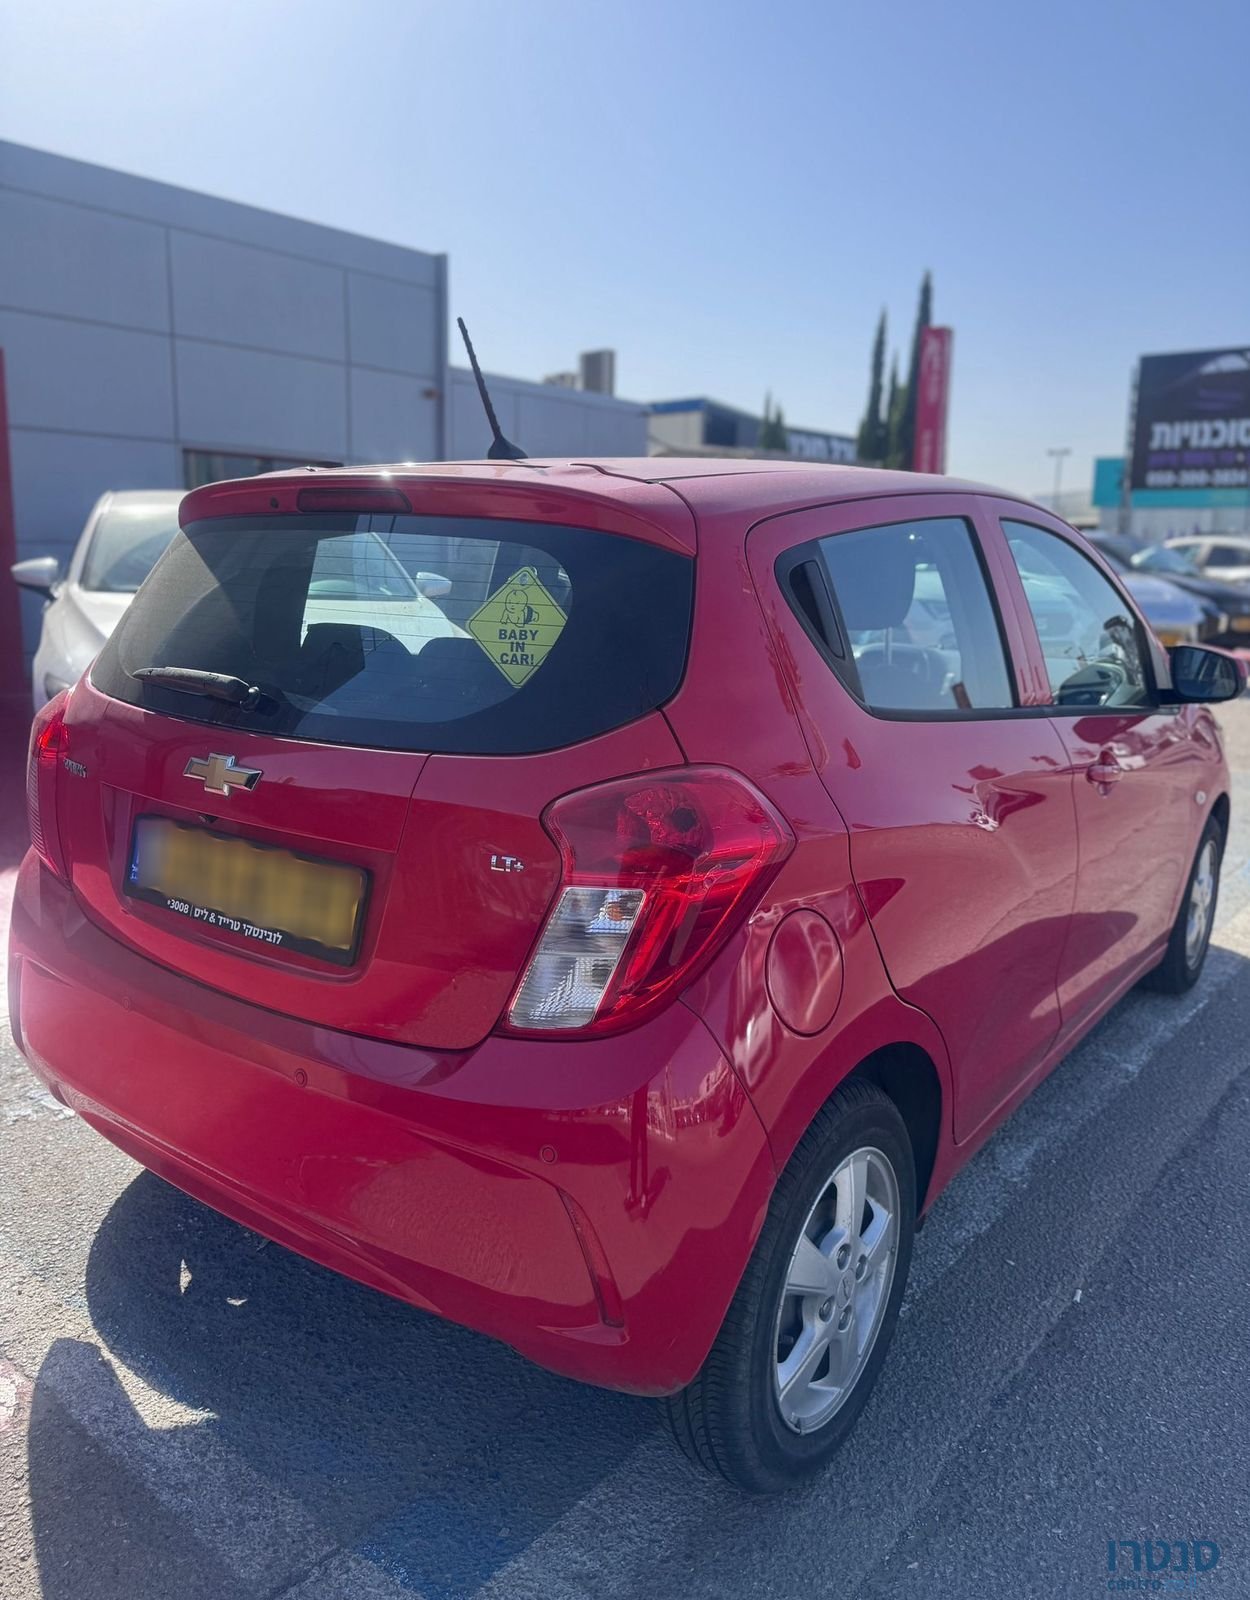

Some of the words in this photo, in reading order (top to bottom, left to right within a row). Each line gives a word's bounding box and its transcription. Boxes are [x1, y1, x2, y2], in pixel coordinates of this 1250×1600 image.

[498, 629, 539, 641] BABY
[510, 642, 525, 653] IN
[500, 653, 534, 665] CAR!
[490, 855, 524, 872] LT+
[209, 912, 216, 924] &
[217, 915, 241, 931] טרייד
[243, 923, 283, 945] לובינסקי
